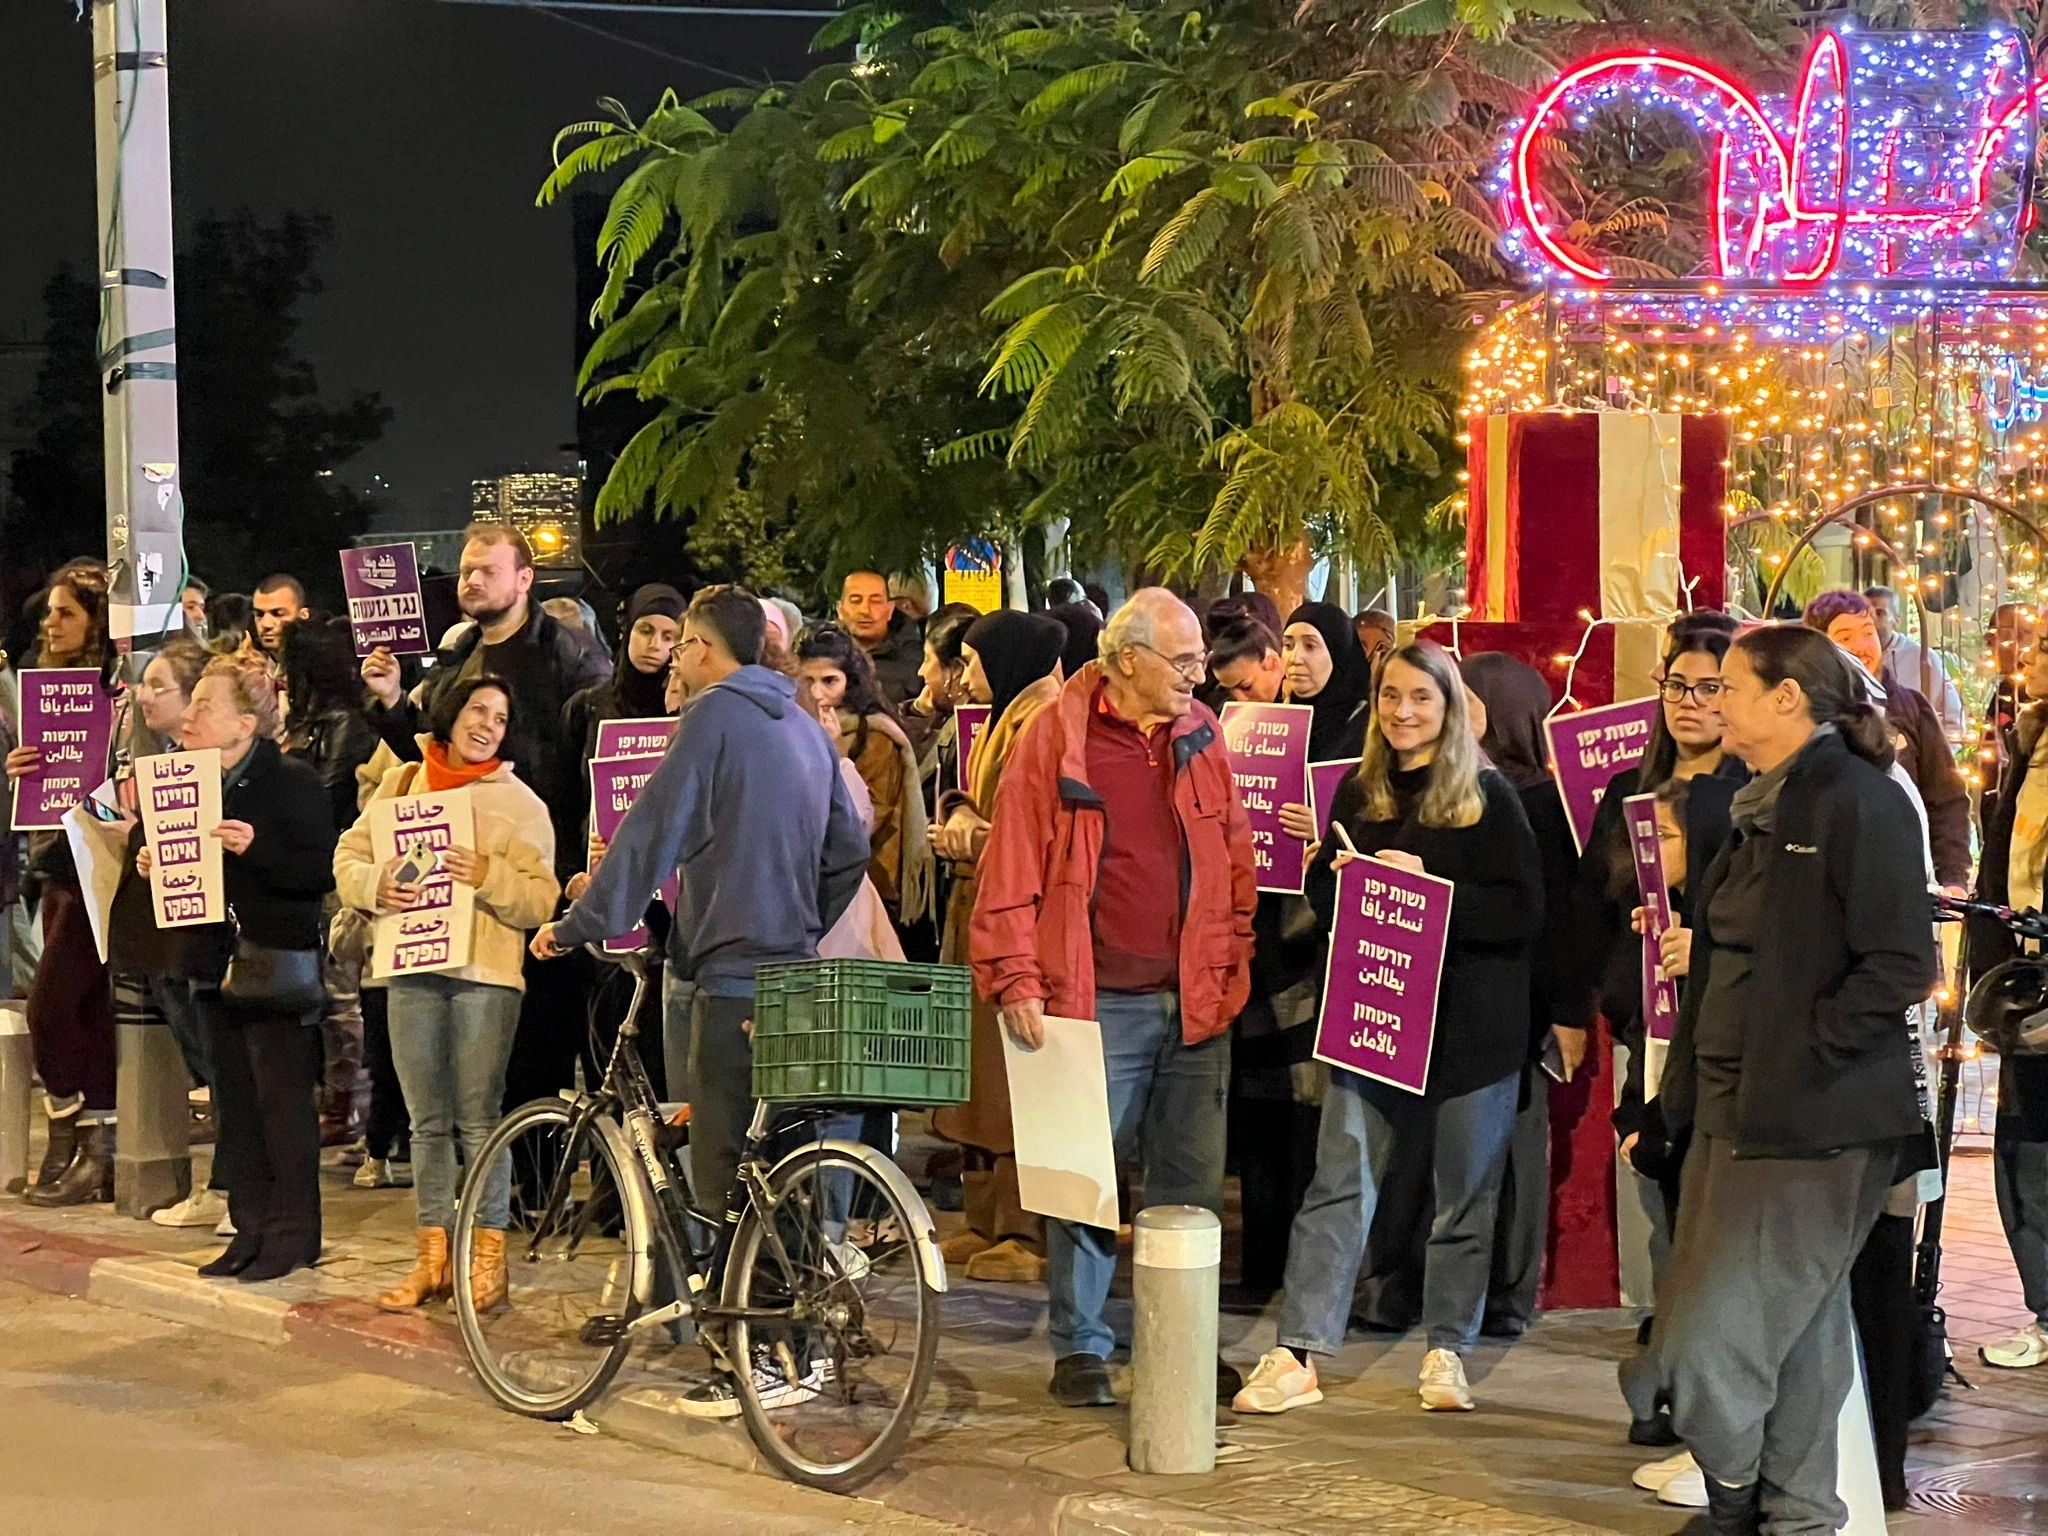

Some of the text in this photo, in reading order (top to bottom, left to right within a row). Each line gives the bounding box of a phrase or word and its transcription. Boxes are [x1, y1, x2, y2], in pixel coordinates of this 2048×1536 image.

[392, 596, 416, 615] נגד
[400, 625, 420, 640] ضد
[40, 684, 93, 696] נשות יפו
[40, 698, 93, 716] نساء يافا
[42, 730, 88, 742] דורשות
[1256, 722, 1289, 736] נשות
[1576, 720, 1648, 747] נשות יפו
[618, 736, 636, 748] יפו
[1254, 738, 1286, 756] نساء
[46, 746, 83, 763] يطالبن
[1580, 746, 1609, 769] يافا
[153, 758, 195, 781] حياتنا
[42, 778, 80, 792] ביטחון
[612, 776, 629, 790] יפו
[155, 786, 196, 808] חיינו
[394, 800, 444, 822] حياتنا
[156, 811, 198, 835] ليست
[160, 840, 198, 863] אינם
[162, 870, 202, 892] رخيصة
[1364, 878, 1426, 910] נשות יפו
[400, 914, 449, 937] رخيصة
[1360, 896, 1424, 933] نساء يافا
[395, 941, 447, 968] הפקר
[1358, 939, 1412, 970] דורשות
[1358, 966, 1406, 996] يطالبن
[1353, 1002, 1402, 1032] ביטחון
[1350, 1028, 1397, 1060] بالأمان
